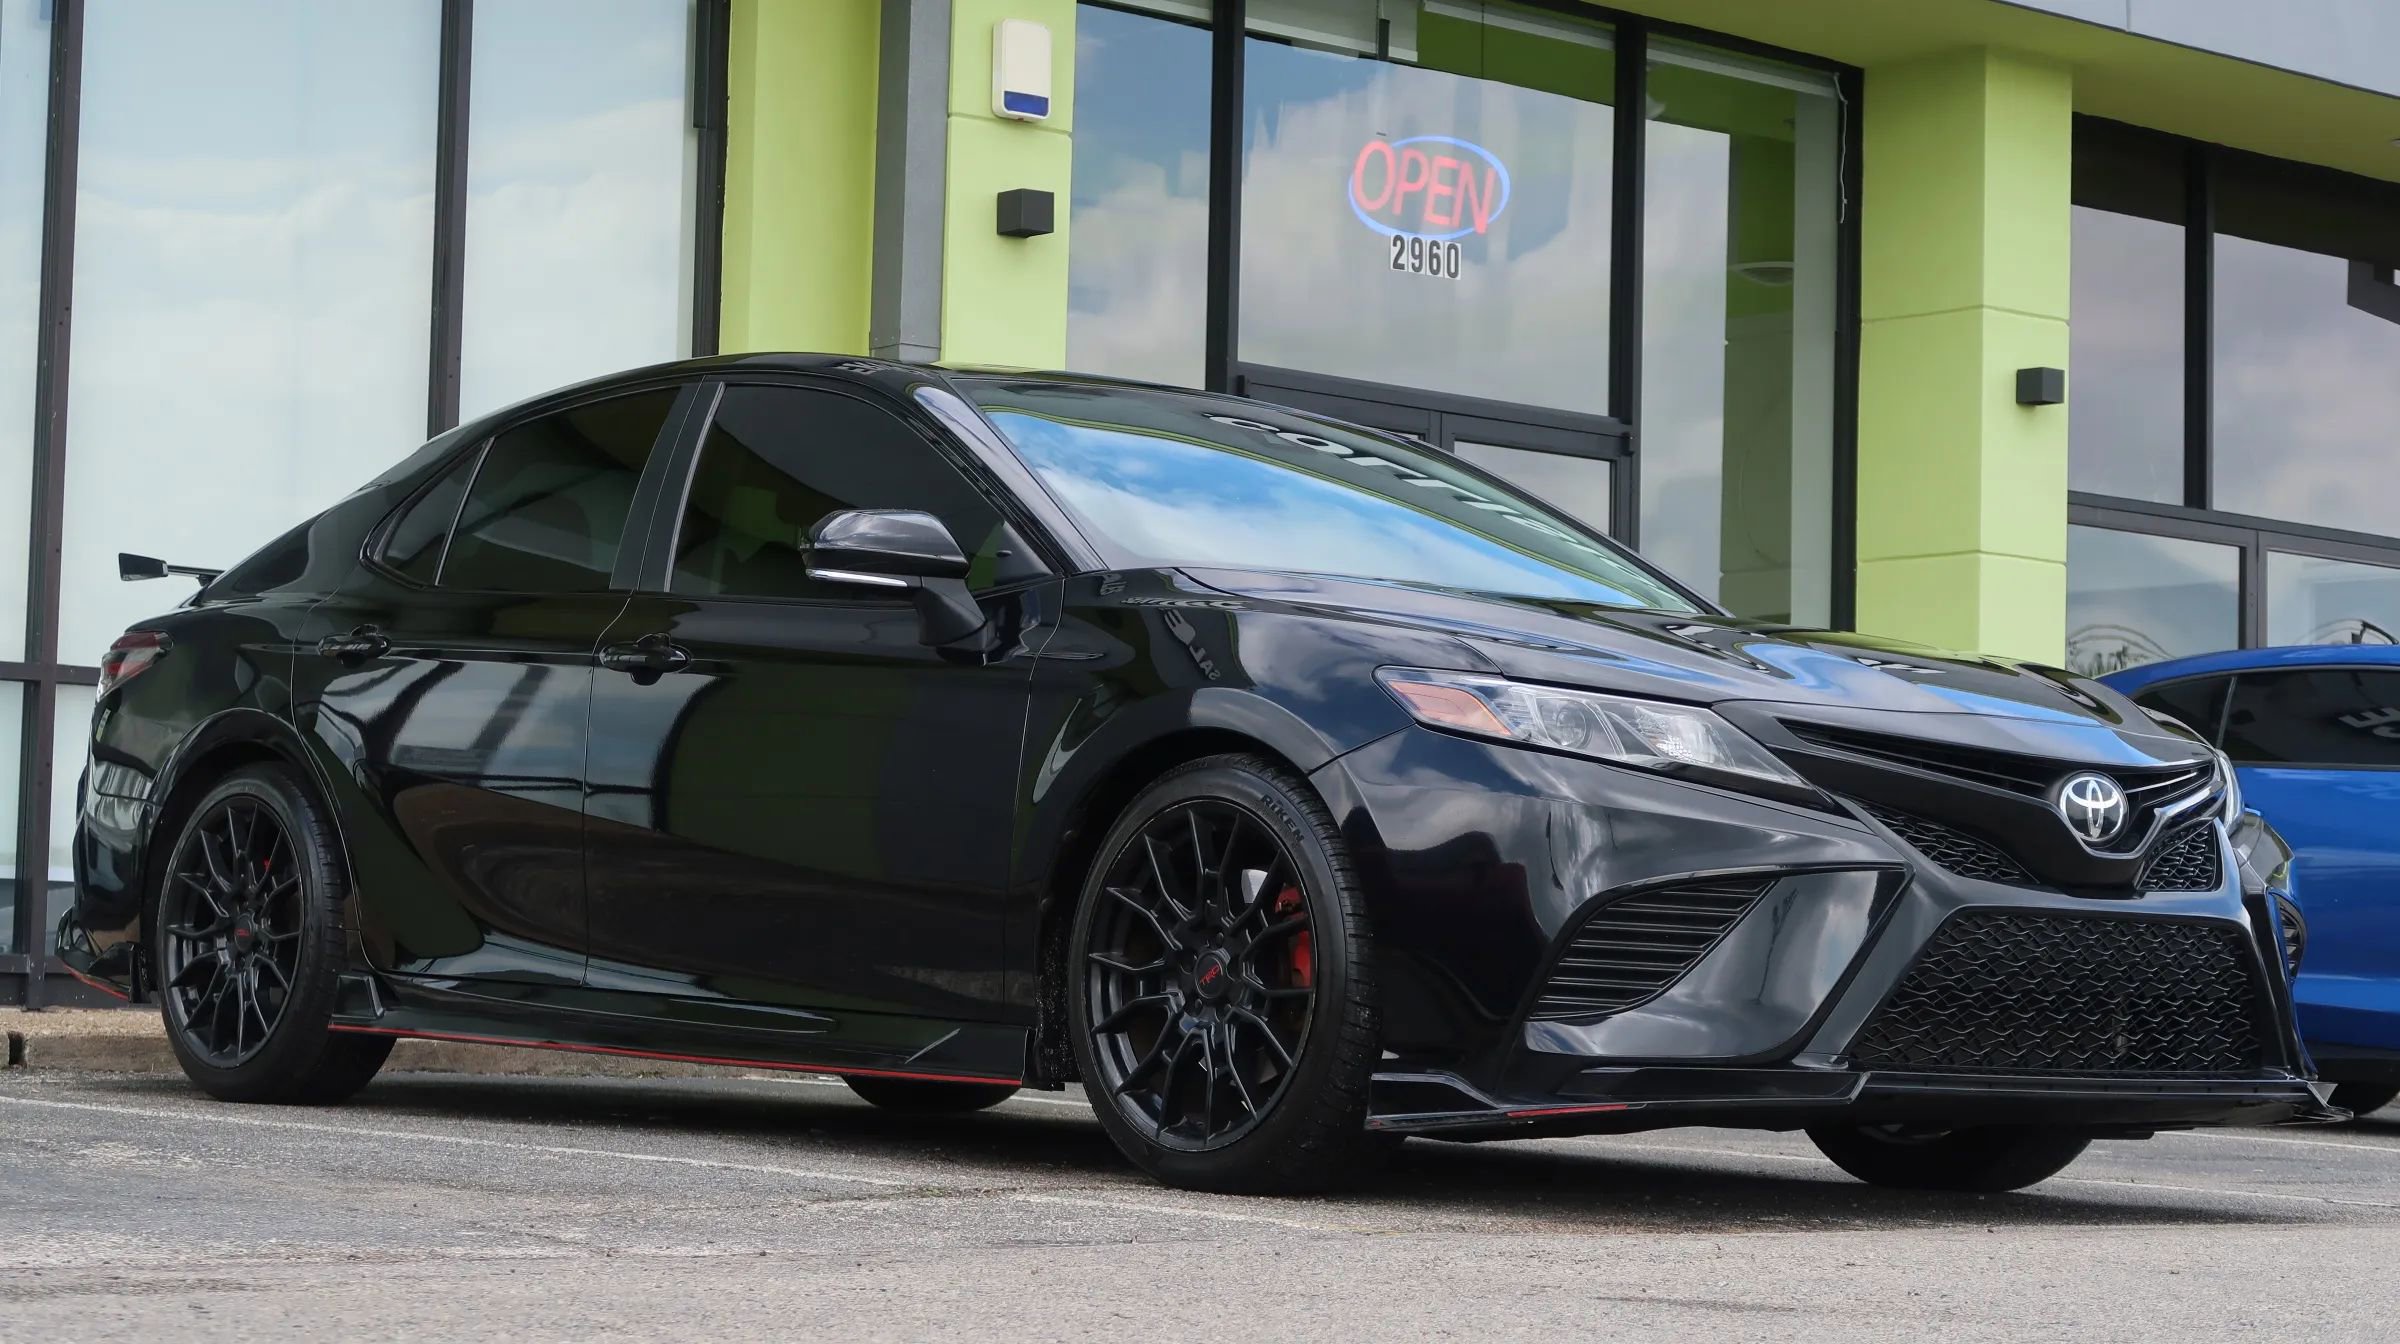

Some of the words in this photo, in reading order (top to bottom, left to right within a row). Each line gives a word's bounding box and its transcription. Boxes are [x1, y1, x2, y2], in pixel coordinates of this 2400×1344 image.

[1353, 140, 1497, 235] OPEN
[1391, 234, 1460, 280] 2960
[1261, 794, 1305, 842] RIKEN
